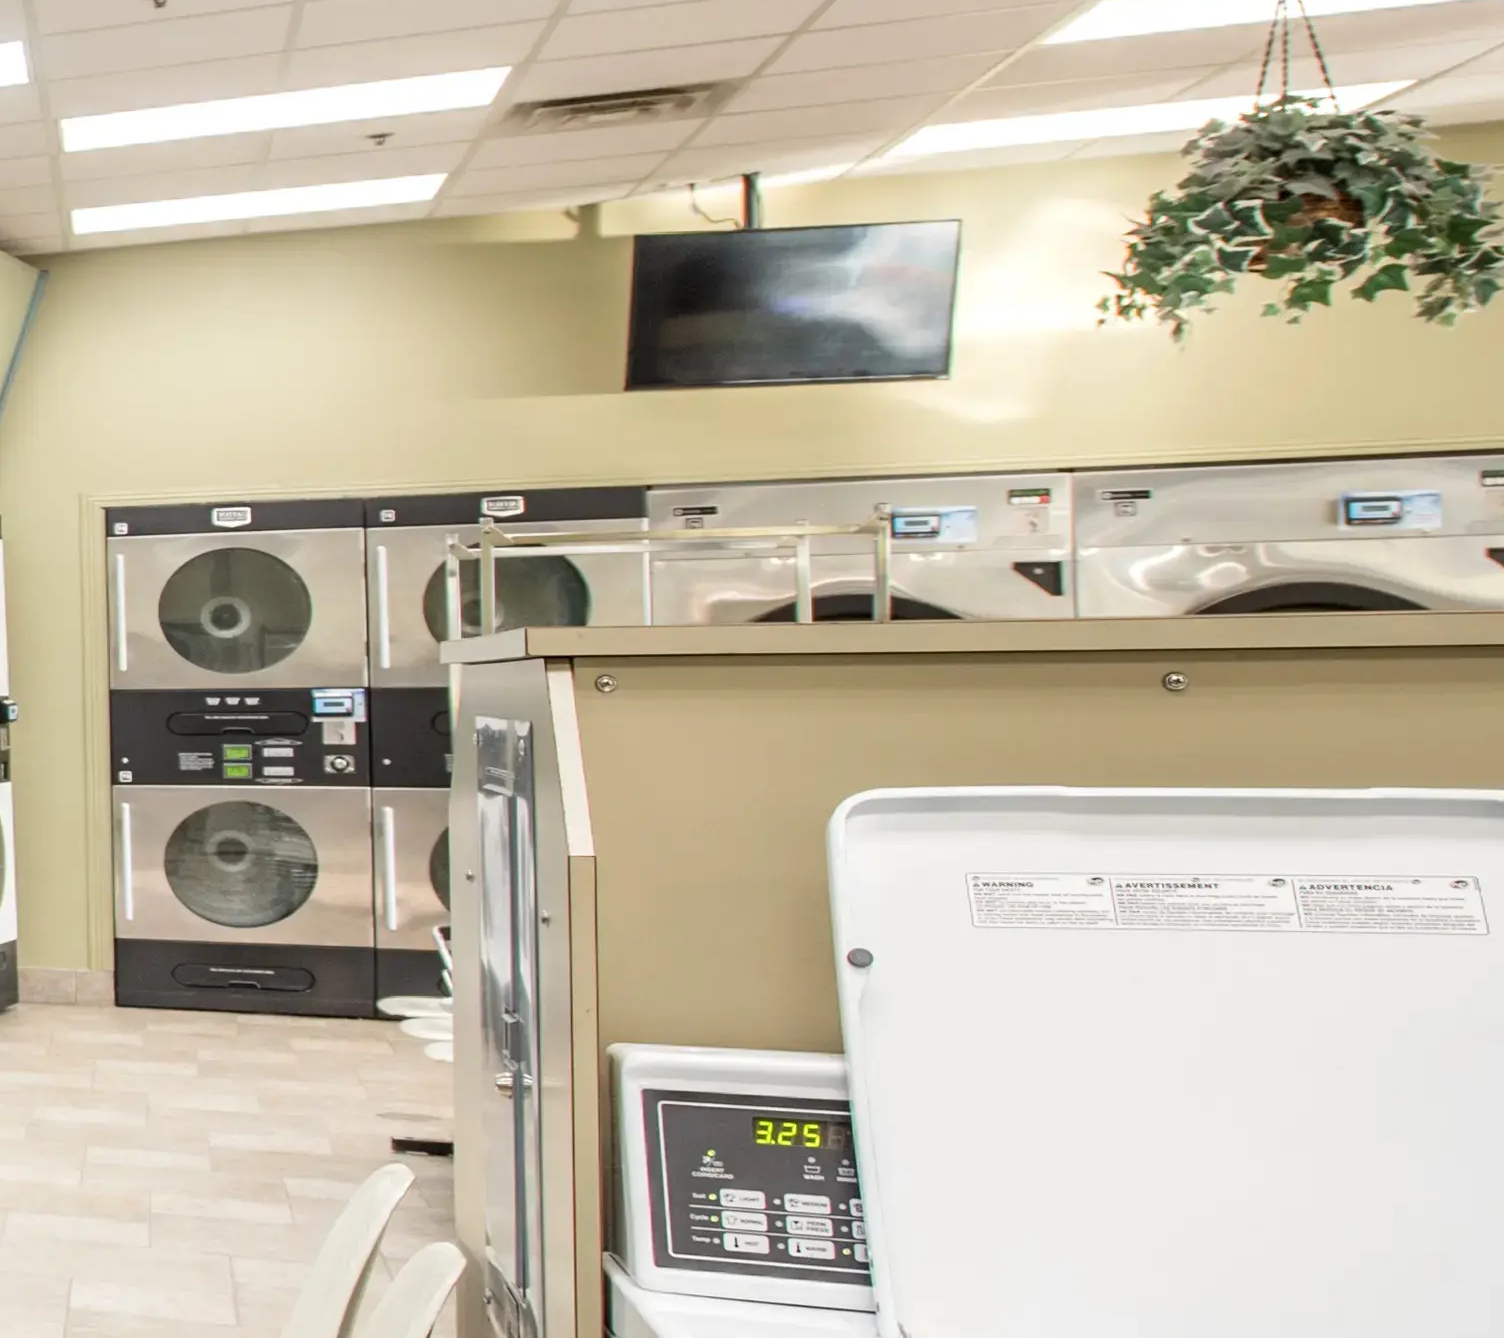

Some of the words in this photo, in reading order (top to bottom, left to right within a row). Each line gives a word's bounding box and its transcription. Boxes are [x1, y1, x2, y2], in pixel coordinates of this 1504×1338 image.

[755, 1120, 821, 1148] 3.25
[690, 1213, 709, 1222] Cycle
[692, 1235, 711, 1244] Temp
